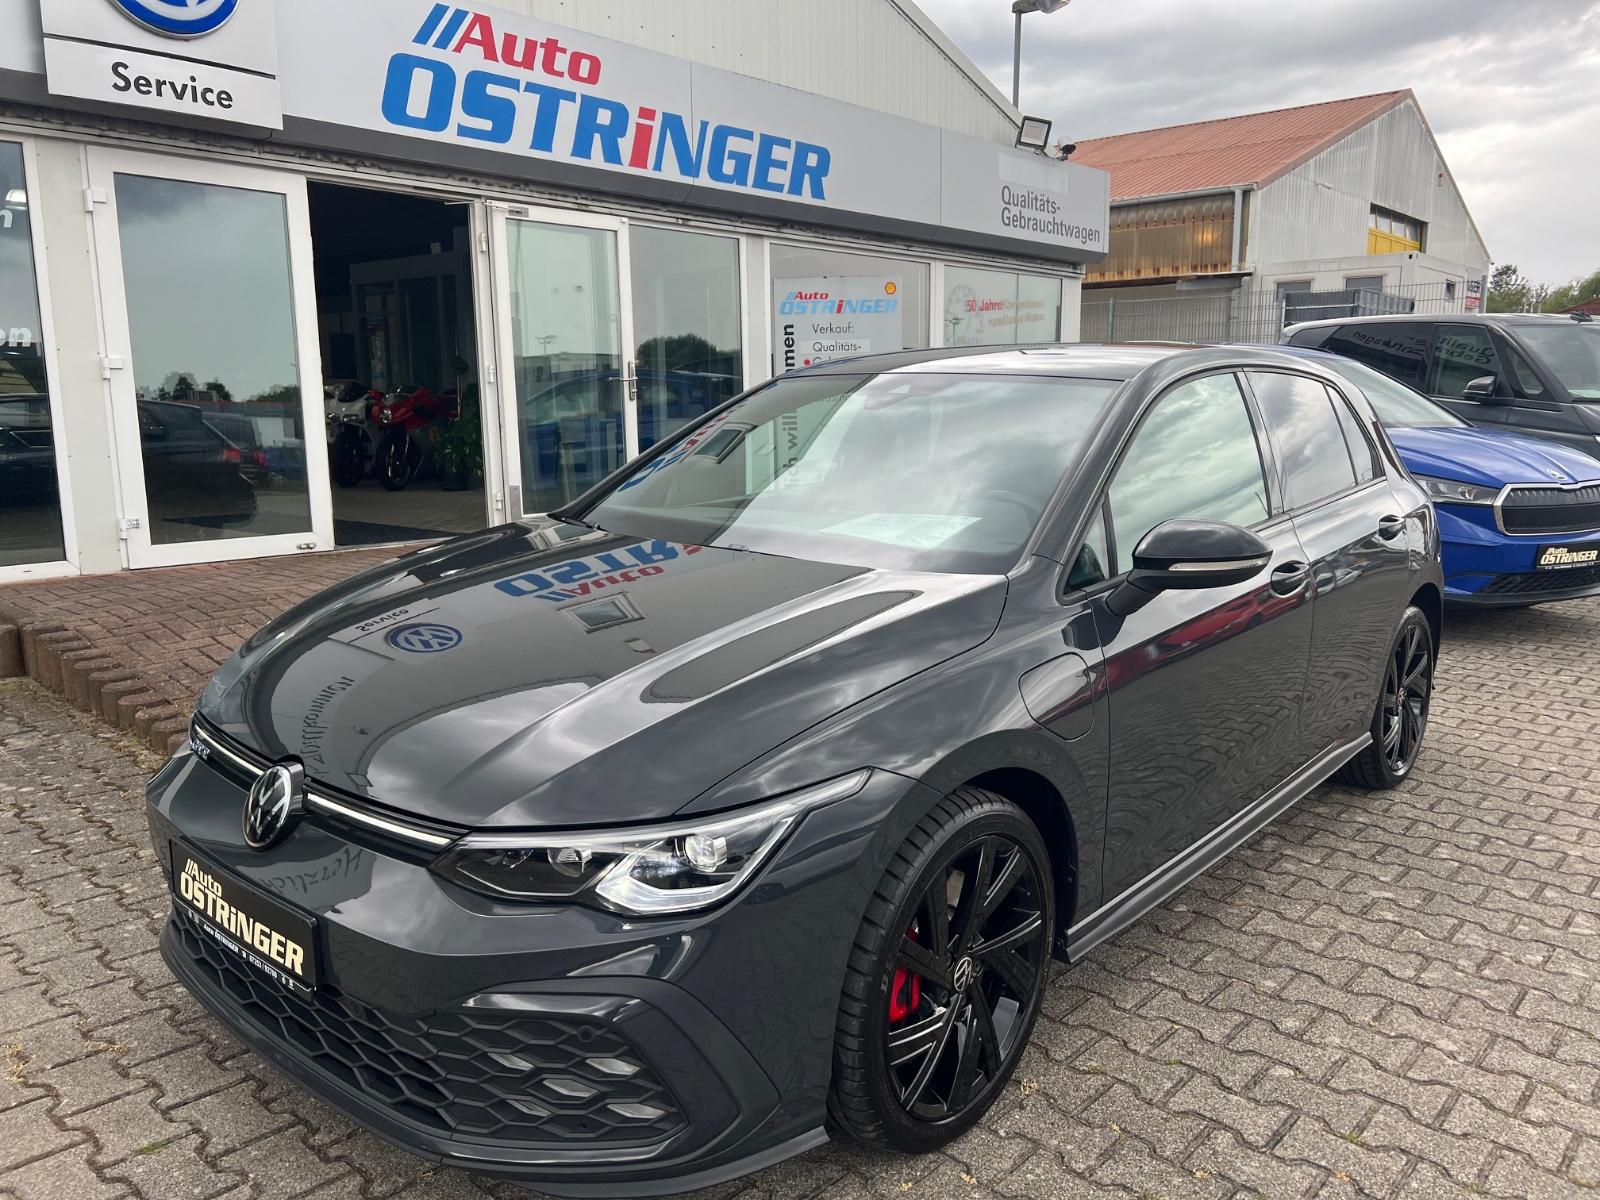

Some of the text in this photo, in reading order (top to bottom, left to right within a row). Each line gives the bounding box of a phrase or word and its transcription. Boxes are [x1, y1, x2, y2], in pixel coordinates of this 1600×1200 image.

[111, 61, 234, 110] Service
[1001, 185, 1061, 215] Qualitäts-
[1001, 206, 1100, 245] Gebrauchtwagen
[812, 322, 854, 334] Verkauf:
[812, 341, 862, 353] Qualitäts-
